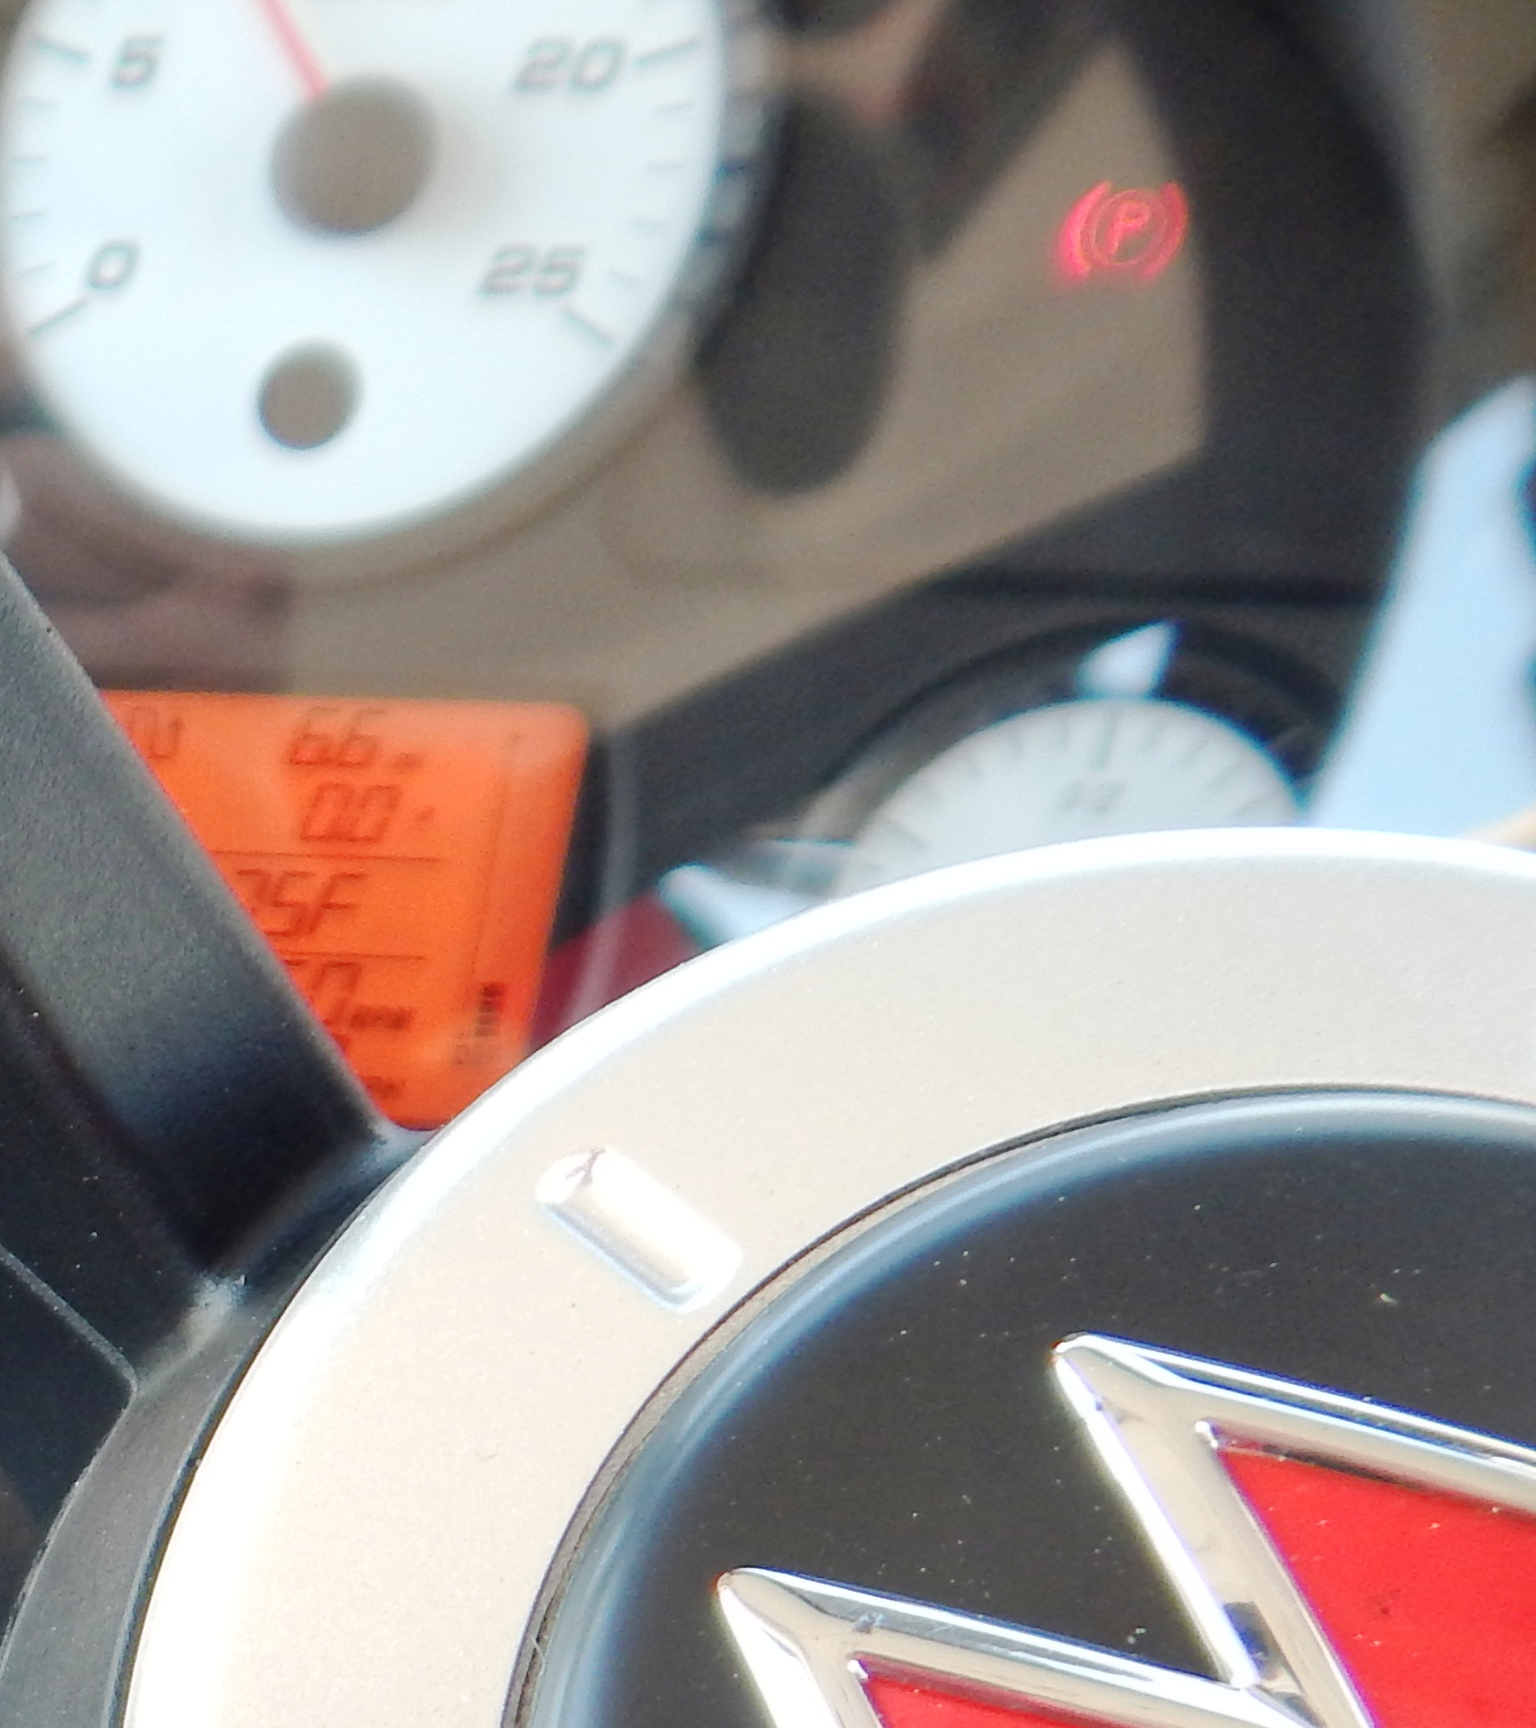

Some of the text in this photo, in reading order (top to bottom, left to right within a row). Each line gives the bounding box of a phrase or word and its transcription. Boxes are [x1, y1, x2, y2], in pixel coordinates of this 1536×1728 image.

[513, 36, 630, 95] 20
[85, 239, 140, 293] 0
[478, 242, 588, 298] 25
